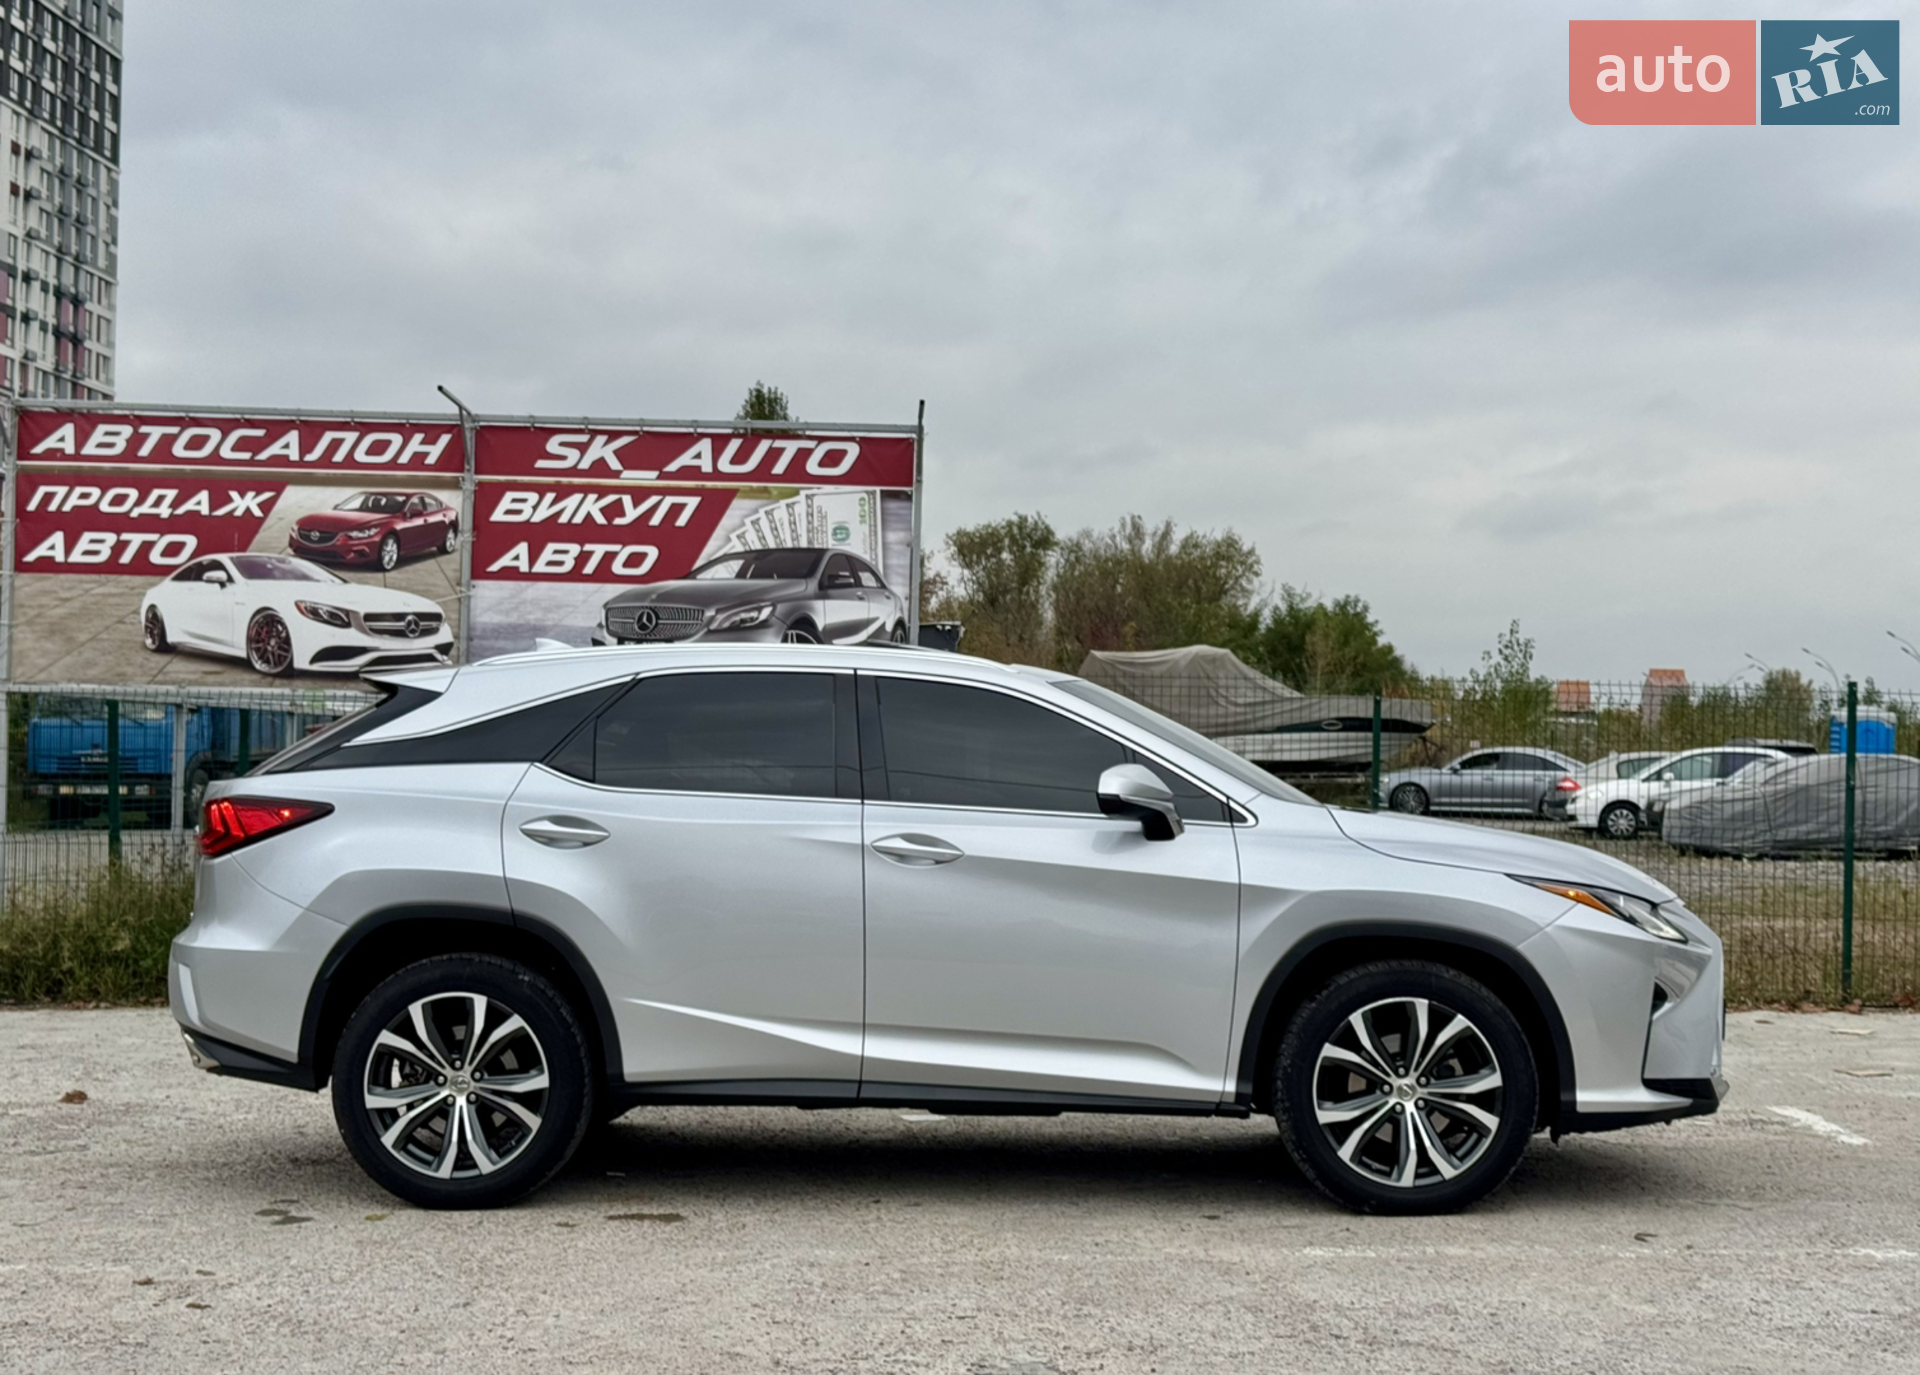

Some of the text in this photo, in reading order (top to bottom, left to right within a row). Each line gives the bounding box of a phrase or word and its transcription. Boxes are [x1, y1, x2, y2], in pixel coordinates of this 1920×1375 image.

[30, 422, 453, 465] АВТОСАЛОН
[534, 433, 861, 480] SK_AUTO
[26, 484, 278, 520] ПРОДАЖ
[489, 490, 702, 528] ВИКУП
[22, 530, 199, 567] АВТО
[485, 541, 660, 577] АВТО
